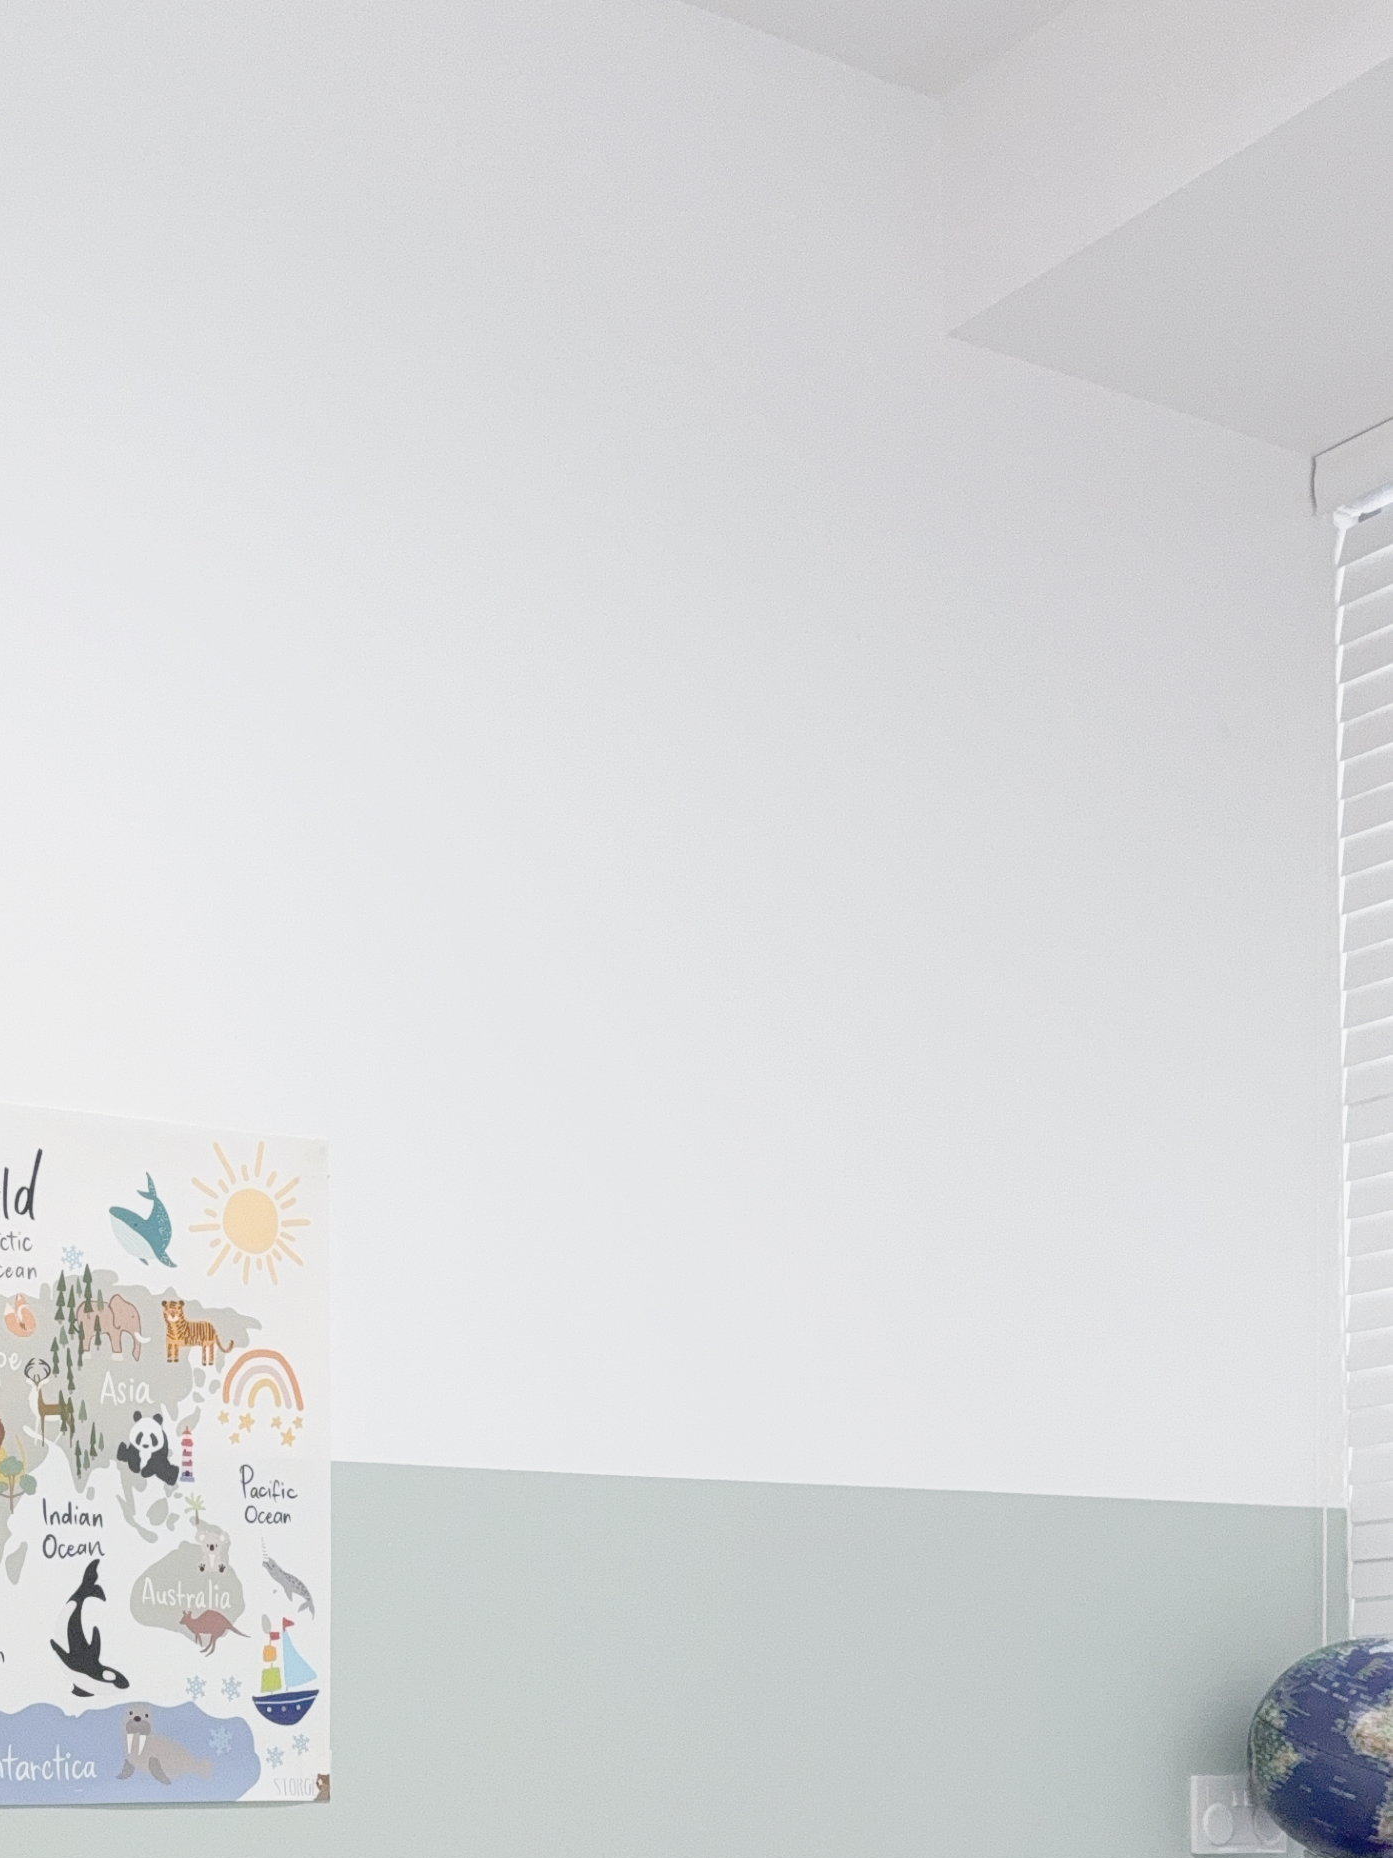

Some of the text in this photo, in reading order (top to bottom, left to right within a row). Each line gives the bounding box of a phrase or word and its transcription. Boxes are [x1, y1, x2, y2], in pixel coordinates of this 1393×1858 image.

[100, 1372, 152, 1405] Asia
[240, 1465, 298, 1500] Pacific
[42, 1498, 104, 1528] Indian
[245, 1505, 291, 1524] Ocean
[42, 1534, 105, 1558] Ocean
[141, 1577, 231, 1610] Australia
